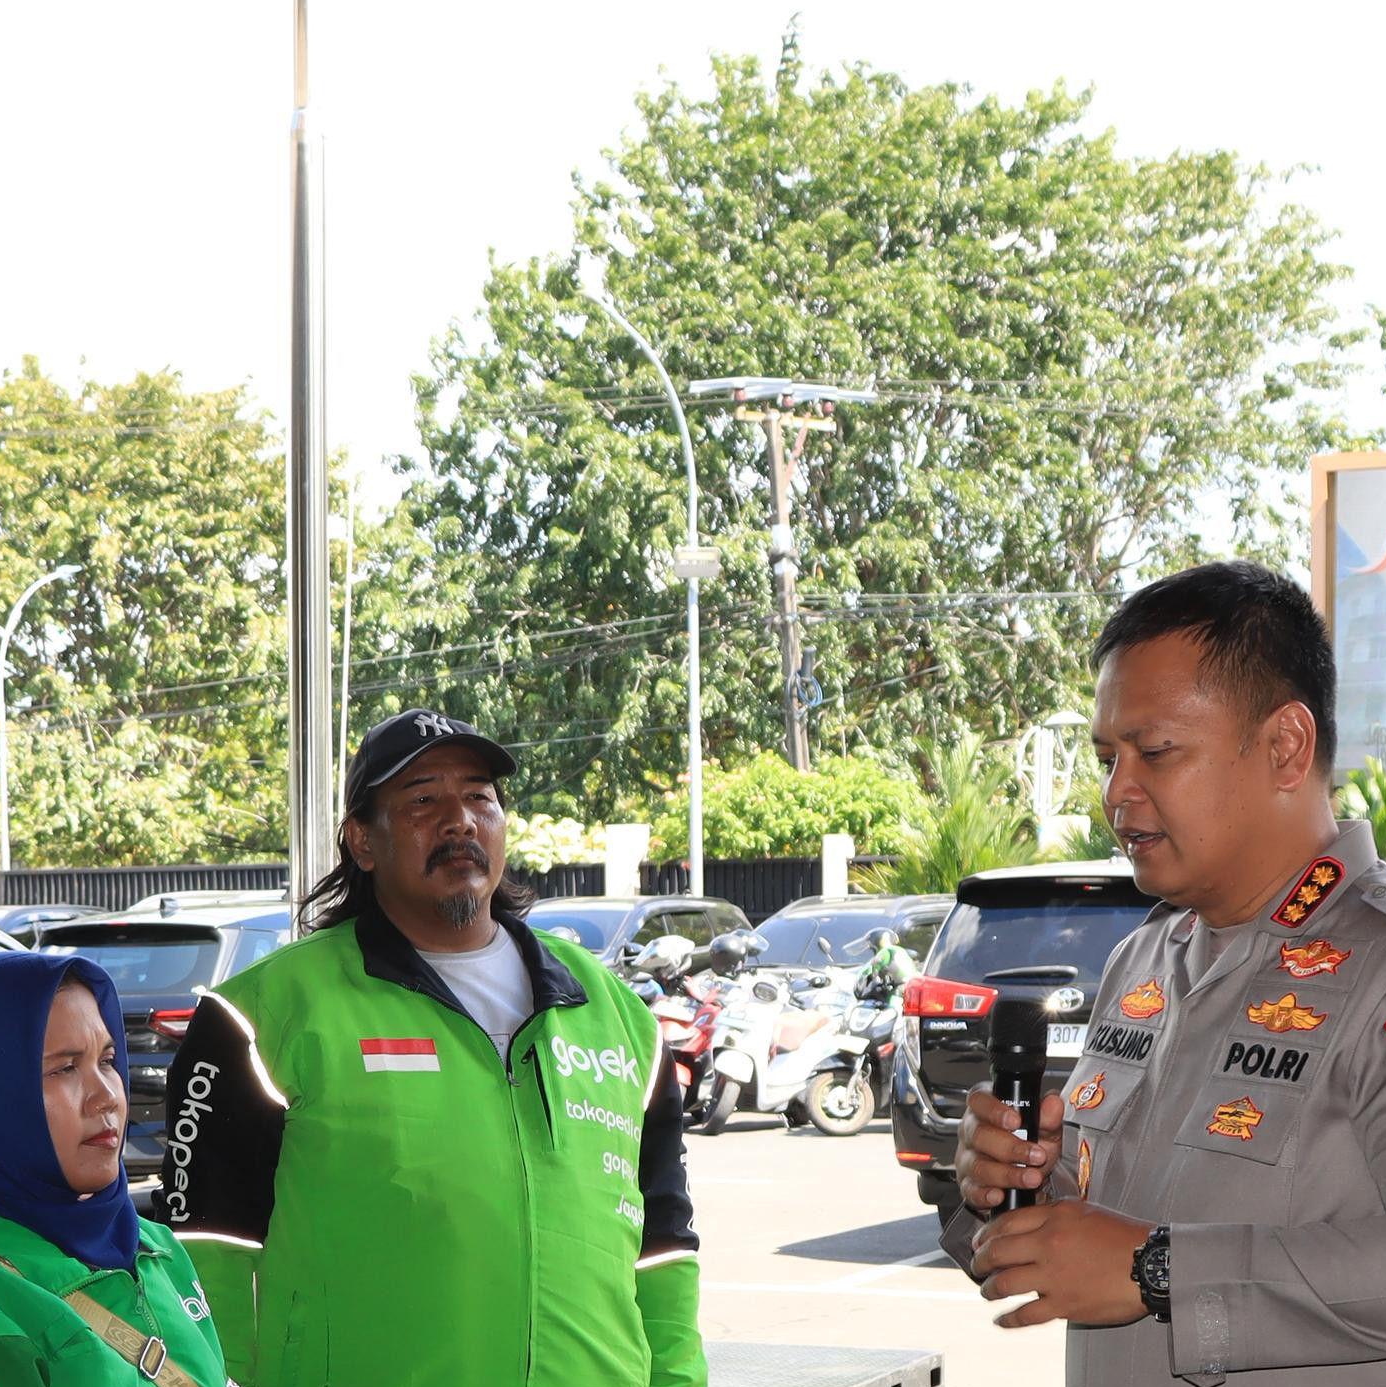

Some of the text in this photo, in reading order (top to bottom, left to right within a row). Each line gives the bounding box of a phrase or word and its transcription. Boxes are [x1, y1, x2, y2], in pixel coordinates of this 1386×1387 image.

[550, 1035, 641, 1087] gojek
[1087, 1024, 1154, 1061] KUSUMO
[1223, 1042, 1310, 1083] POLRI
